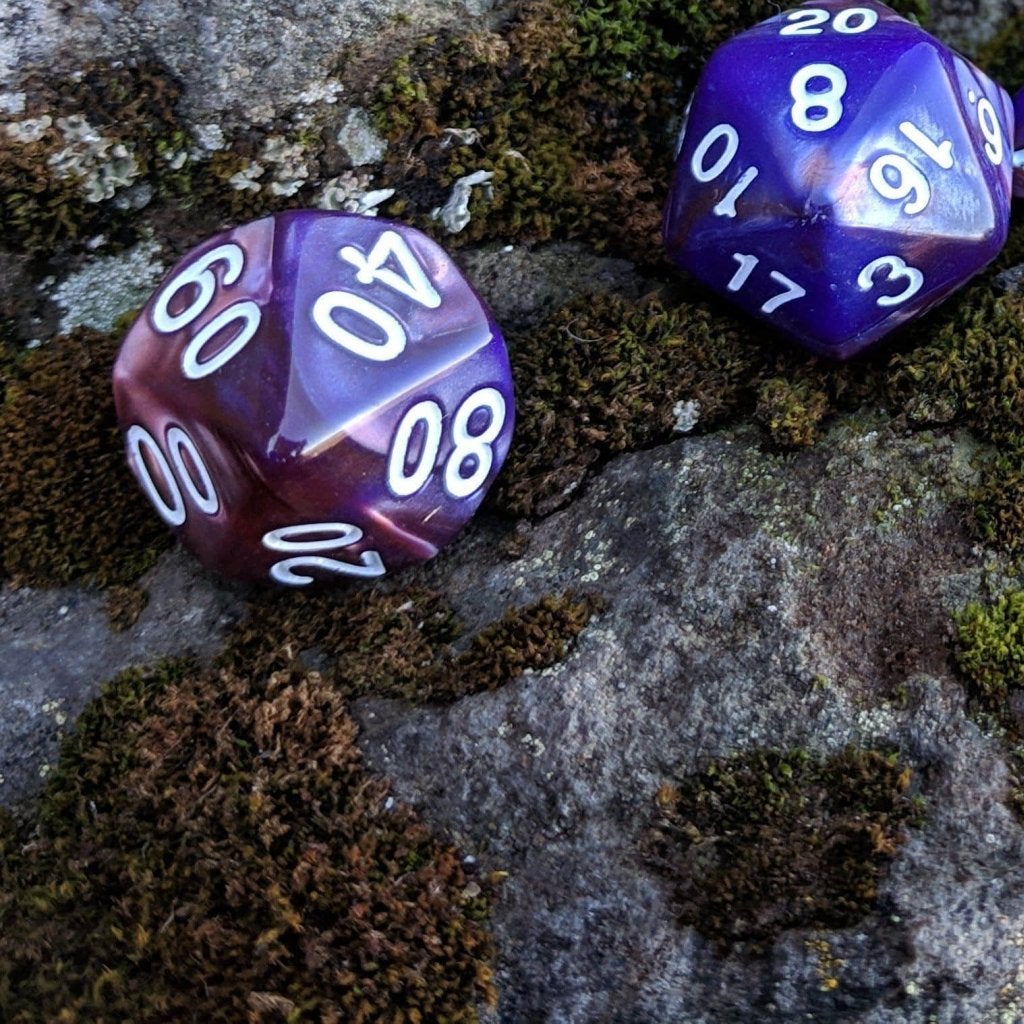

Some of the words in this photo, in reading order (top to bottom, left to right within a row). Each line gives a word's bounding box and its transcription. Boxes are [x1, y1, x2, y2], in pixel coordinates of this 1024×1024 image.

[778, 7, 879, 36] 20
[789, 62, 848, 132] 8
[312, 230, 442, 362] 40
[725, 252, 806, 314] 17
[857, 254, 925, 307] 3
[127, 424, 219, 527] 00
[387, 387, 507, 499] 80
